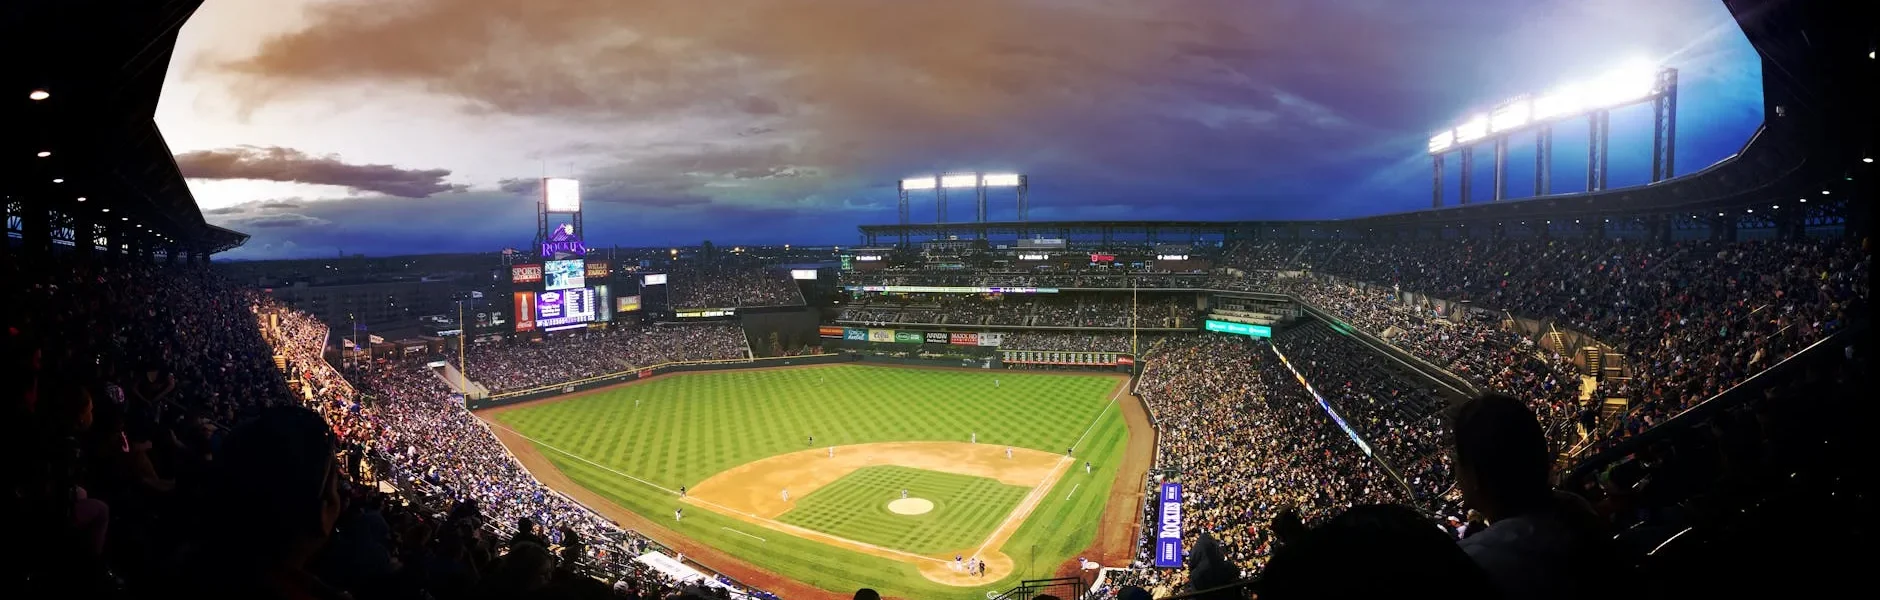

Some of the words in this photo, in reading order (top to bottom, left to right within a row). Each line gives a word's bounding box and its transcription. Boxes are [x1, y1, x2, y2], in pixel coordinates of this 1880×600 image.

[542, 241, 585, 257] ROCKIES
[512, 267, 542, 275] SPORTS
[1160, 503, 1180, 539] ROCKIES
